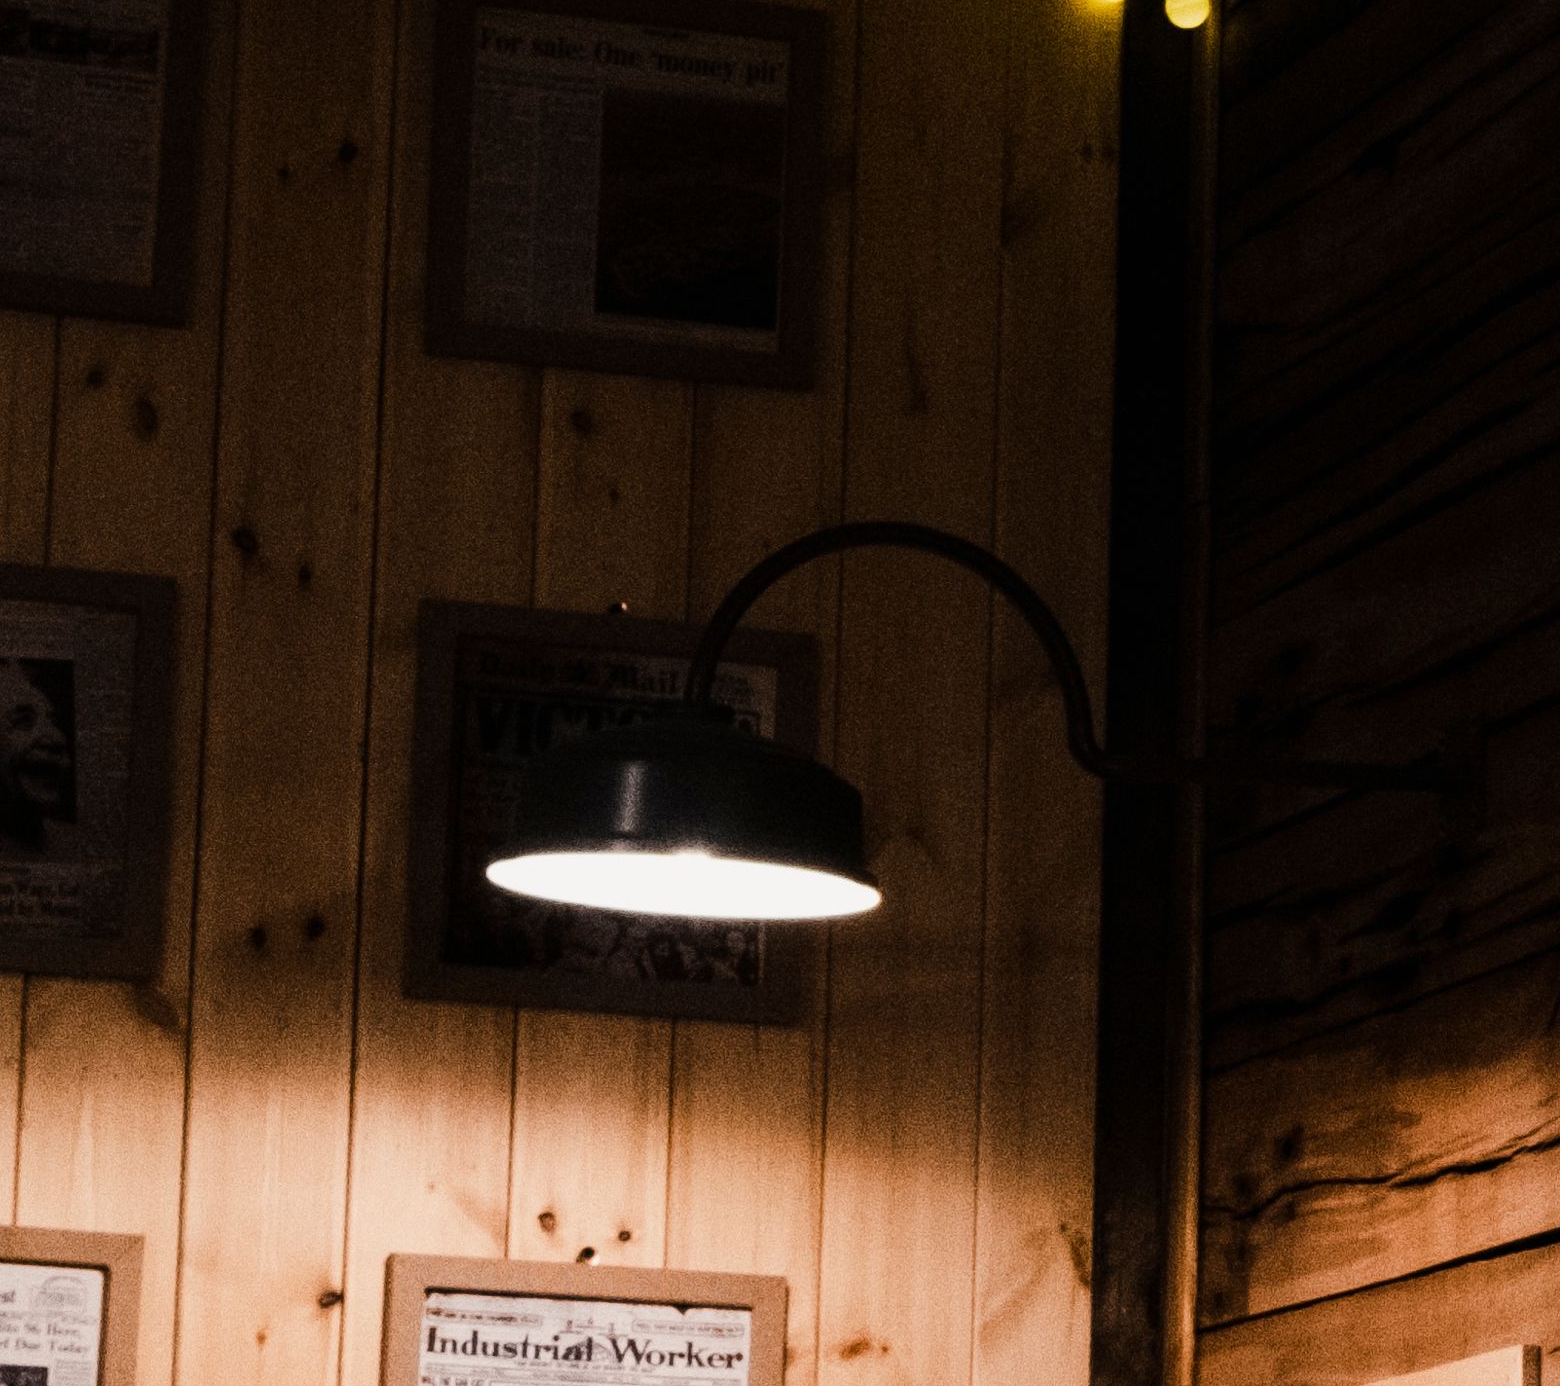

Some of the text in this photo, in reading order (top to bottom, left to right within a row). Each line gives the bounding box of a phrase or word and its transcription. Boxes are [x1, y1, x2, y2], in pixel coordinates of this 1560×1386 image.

[480, 26, 523, 56] For
[594, 41, 640, 67] One
[426, 1326, 593, 1363] Industrial
[609, 1335, 744, 1369] Worker
